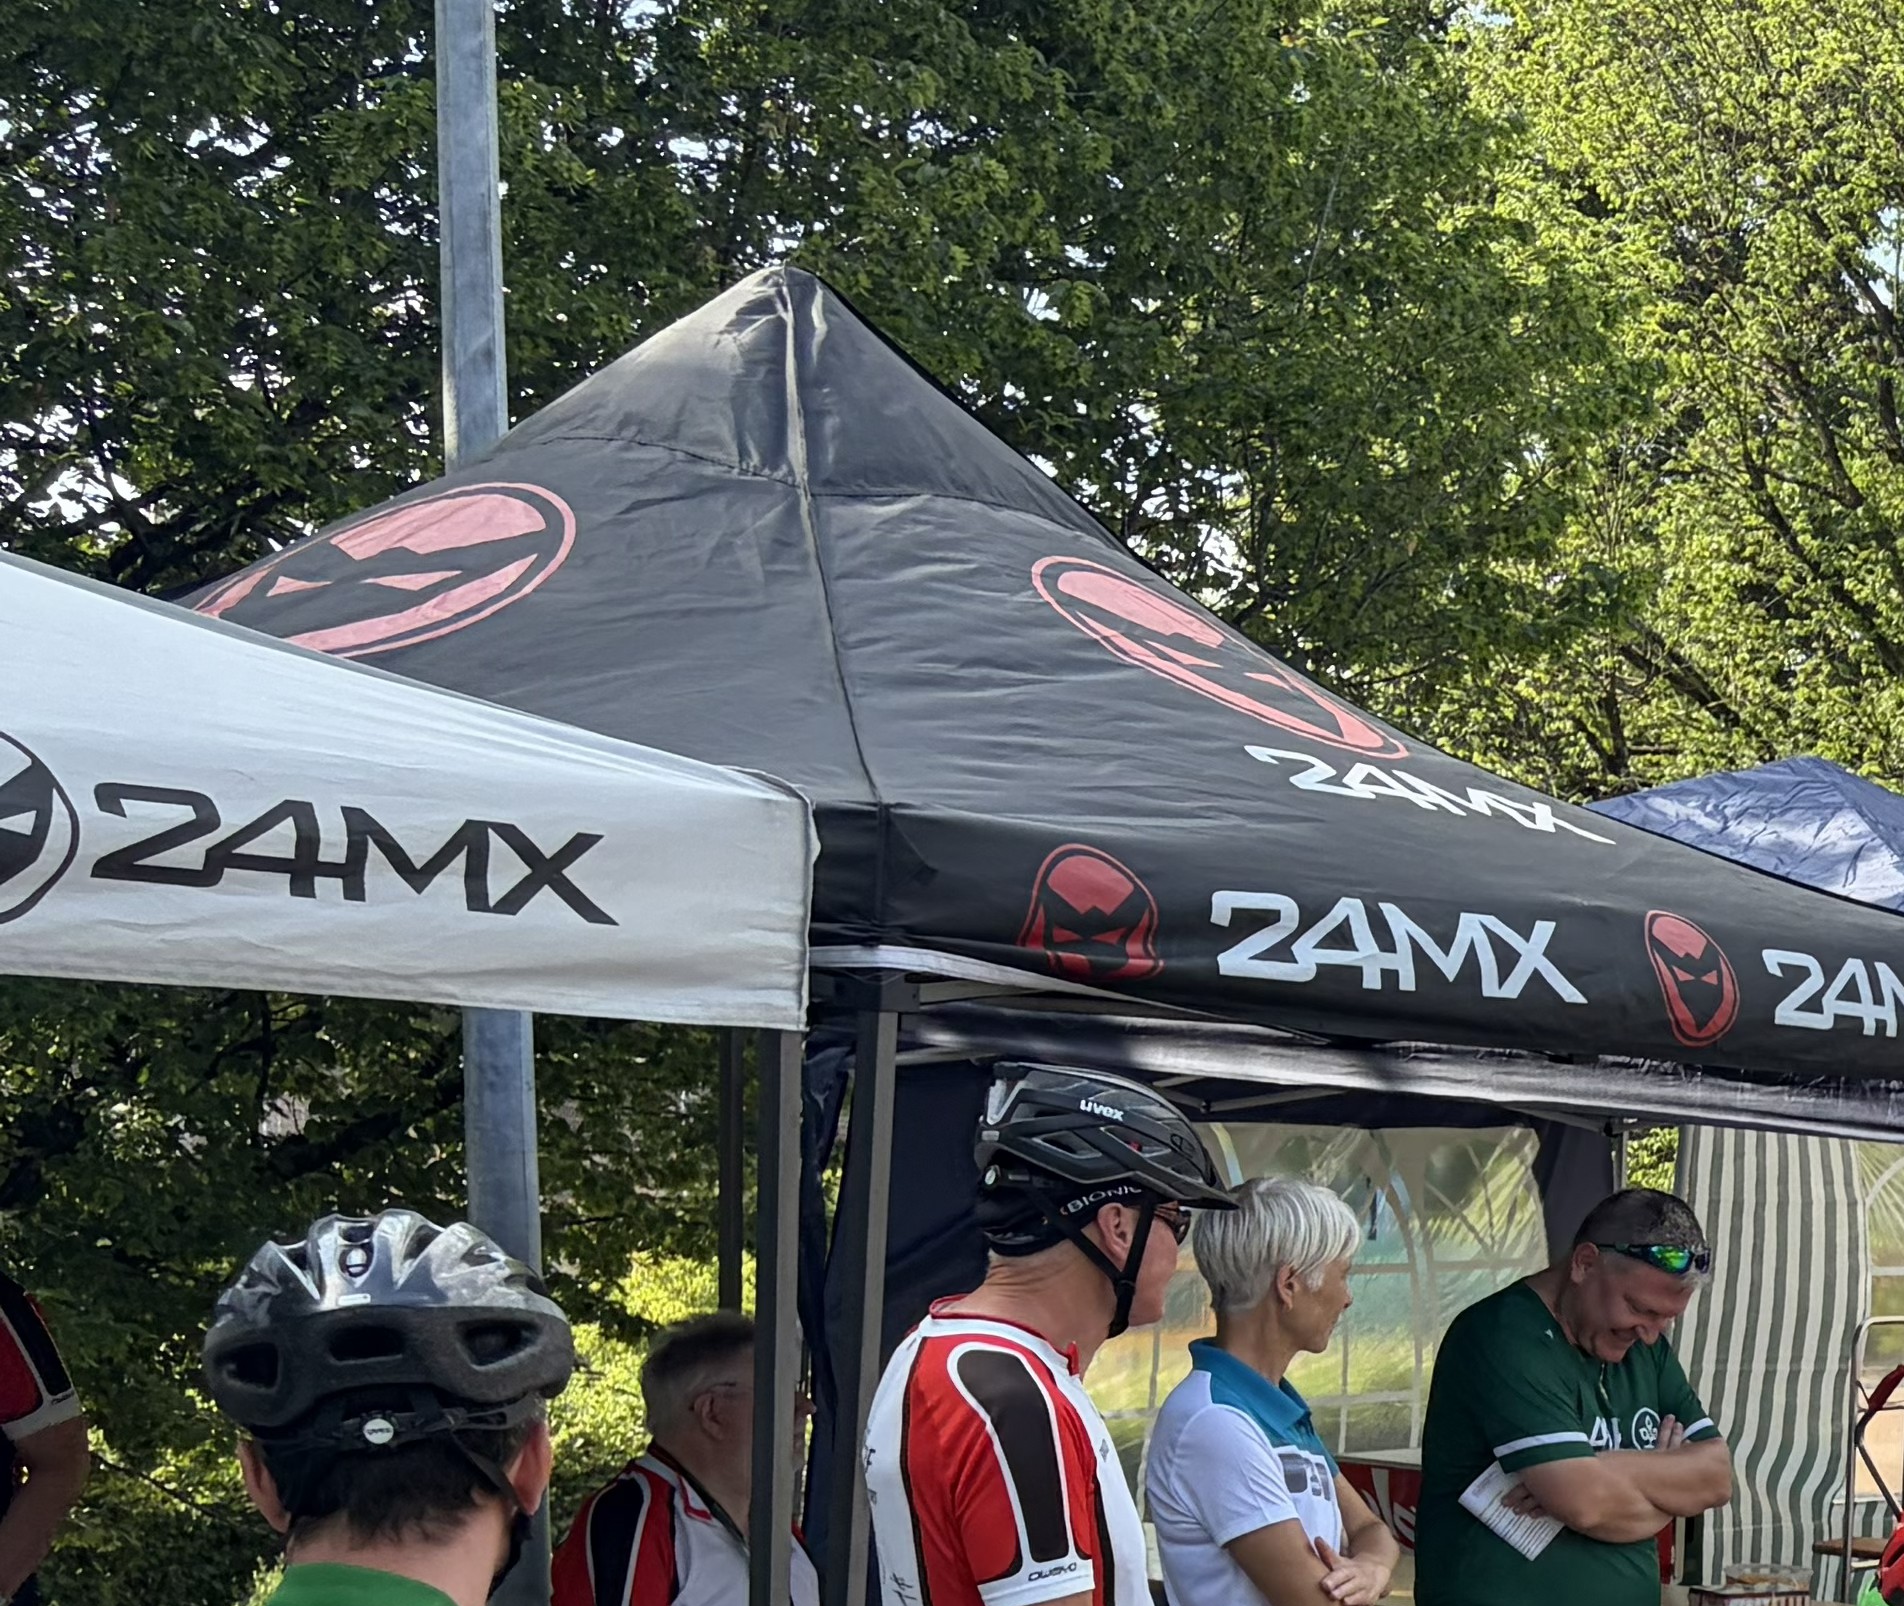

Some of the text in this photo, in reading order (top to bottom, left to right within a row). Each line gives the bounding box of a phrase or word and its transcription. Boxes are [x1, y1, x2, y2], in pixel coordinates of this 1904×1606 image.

[1244, 743, 1618, 846] 24MX
[90, 782, 619, 926] 24MX
[1210, 889, 1588, 1004] 24MX
